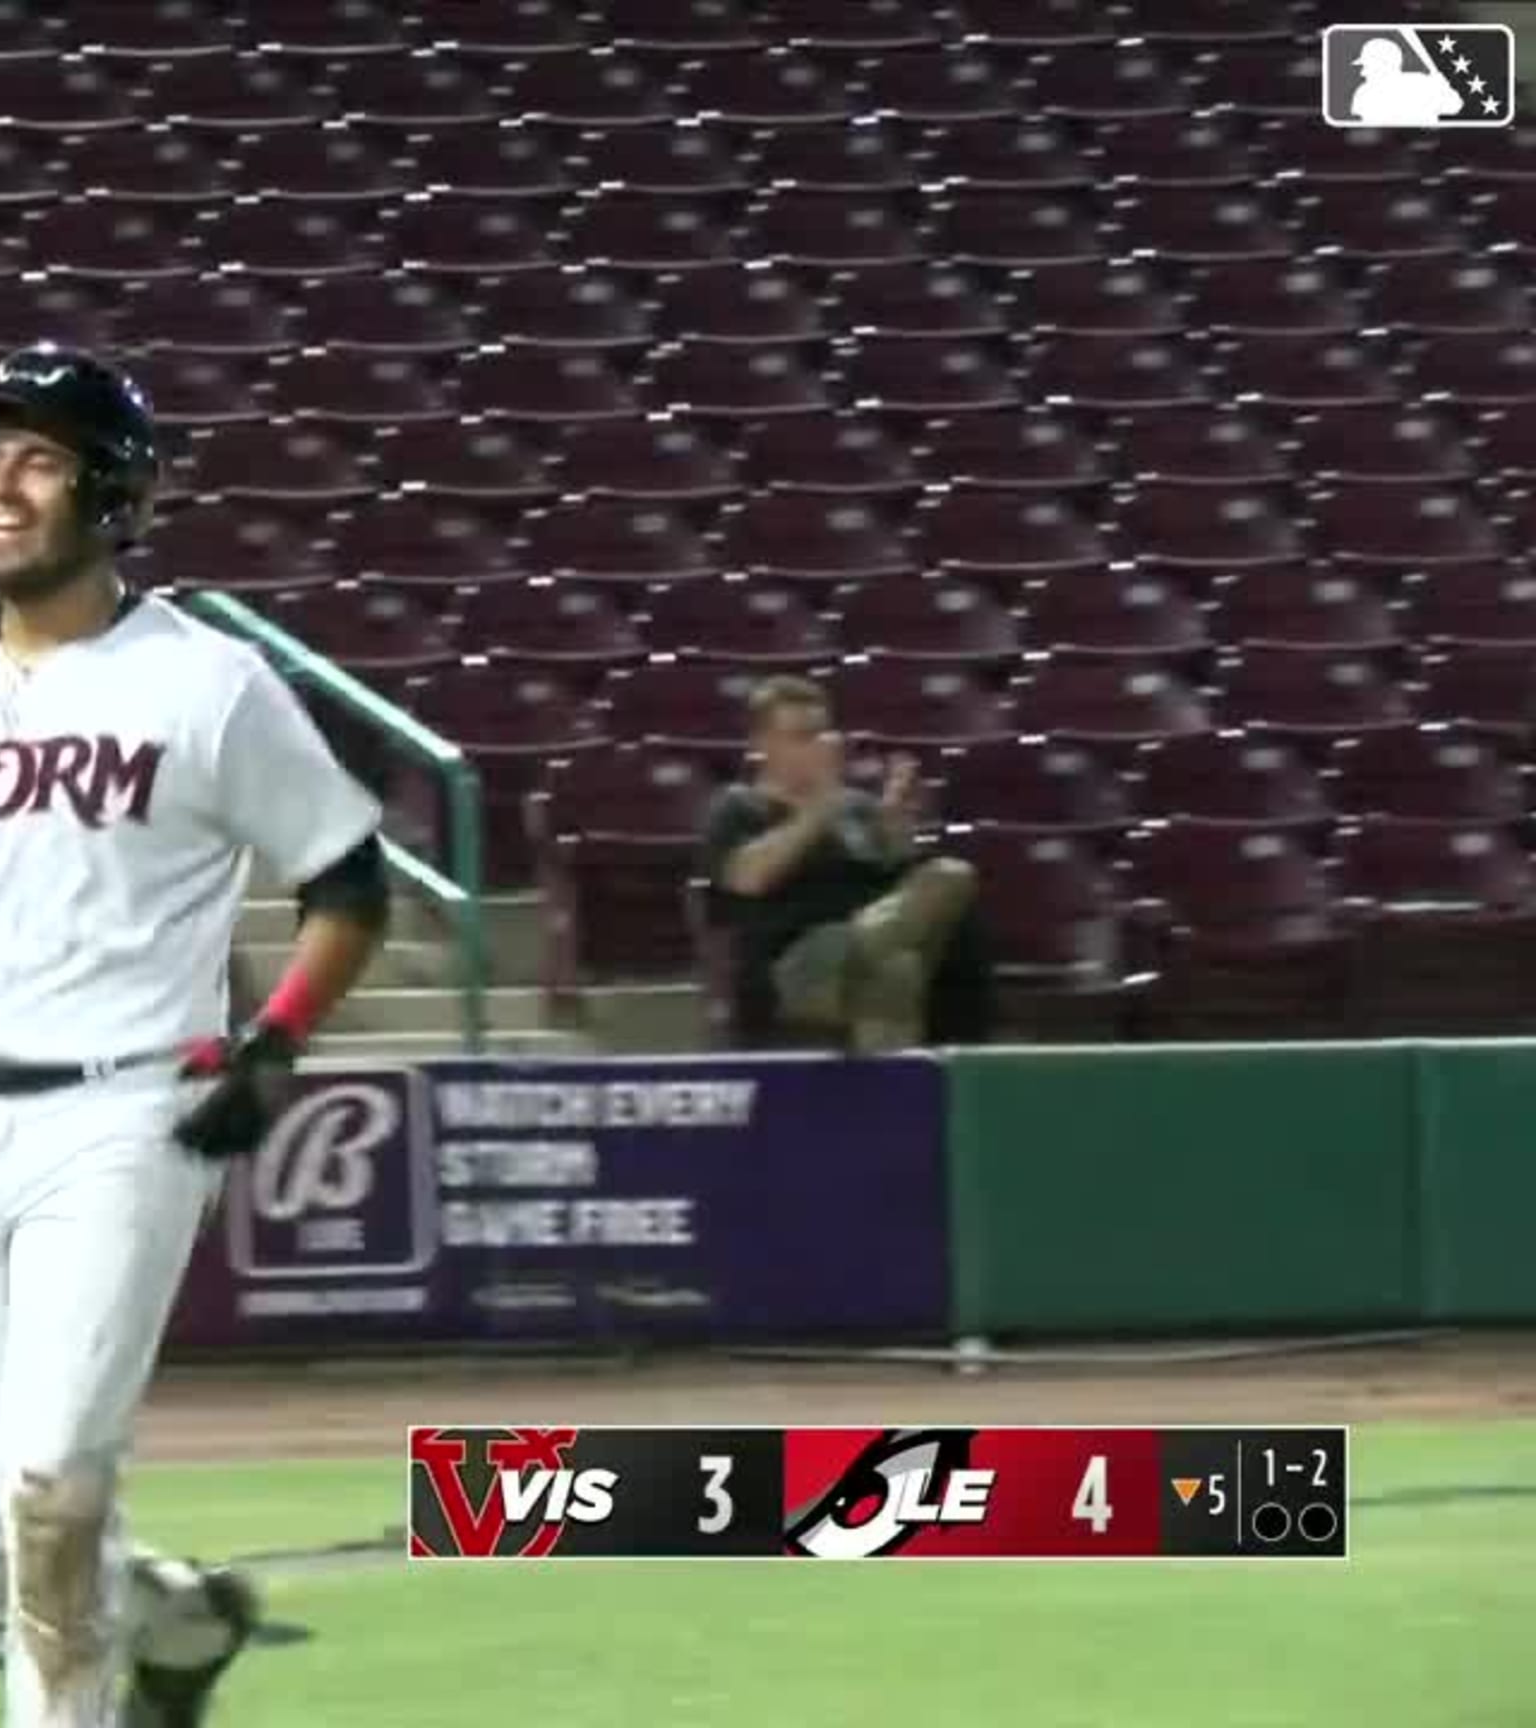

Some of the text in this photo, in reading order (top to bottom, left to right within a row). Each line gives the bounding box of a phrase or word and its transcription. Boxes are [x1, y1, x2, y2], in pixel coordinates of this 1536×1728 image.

[437, 1080, 759, 1128] WATCH EVERY
[440, 1141, 599, 1187] STORM
[441, 1198, 697, 1247] GAME FREE
